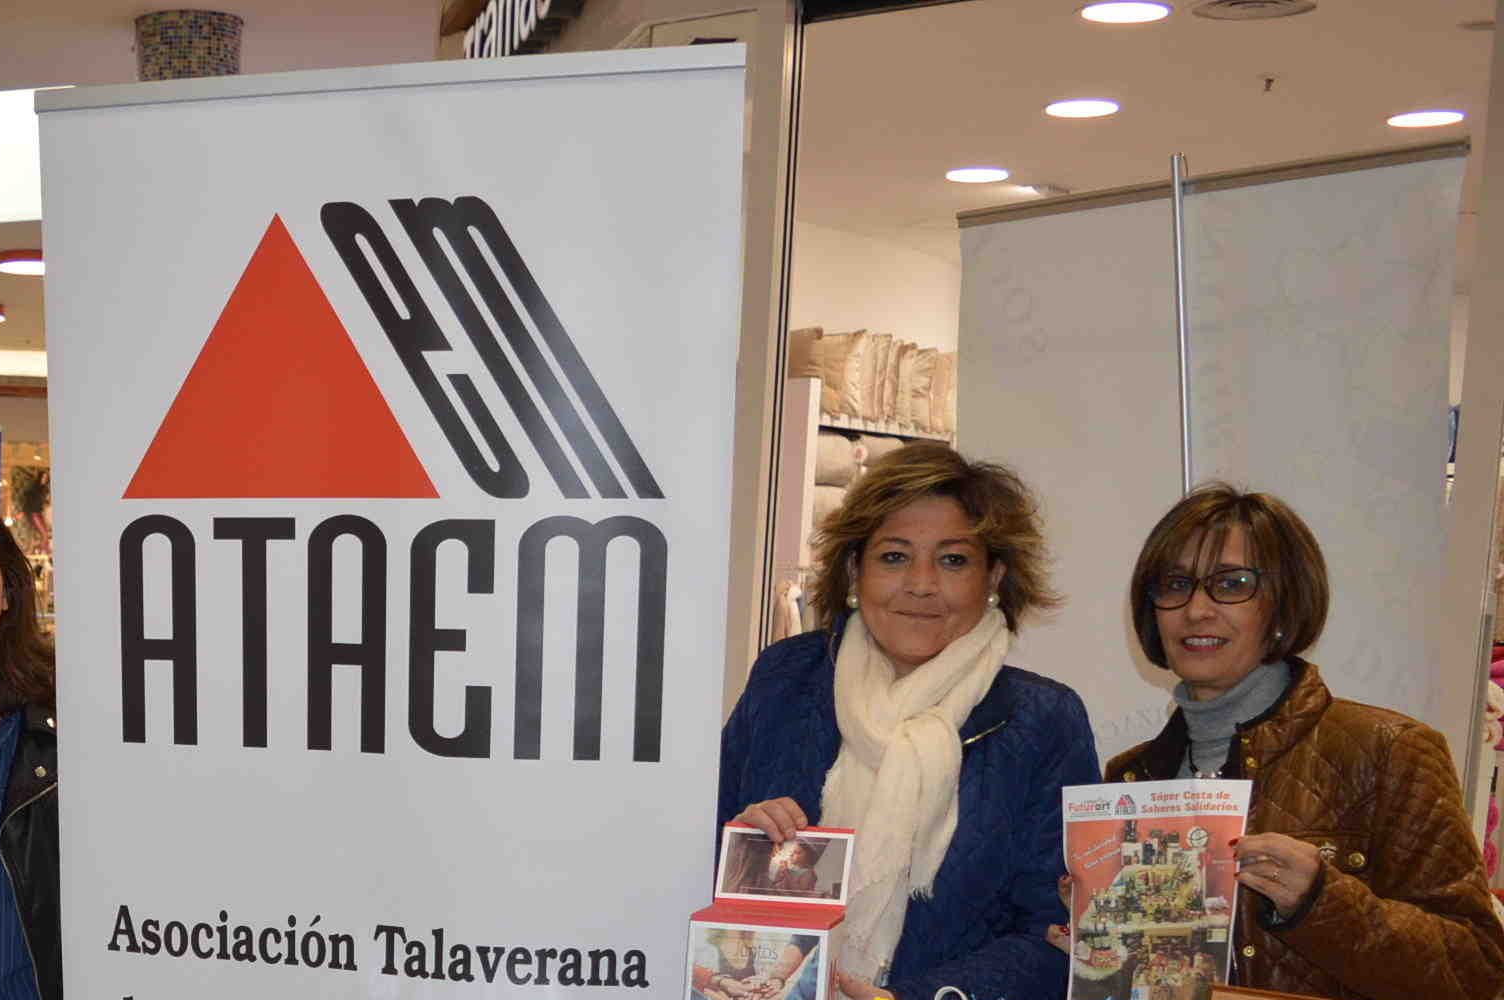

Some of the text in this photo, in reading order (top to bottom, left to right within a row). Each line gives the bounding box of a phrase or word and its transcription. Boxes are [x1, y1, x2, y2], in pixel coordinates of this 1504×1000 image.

[119, 514, 668, 763] ATAEM
[108, 903, 649, 988] Asociación Talaverana
